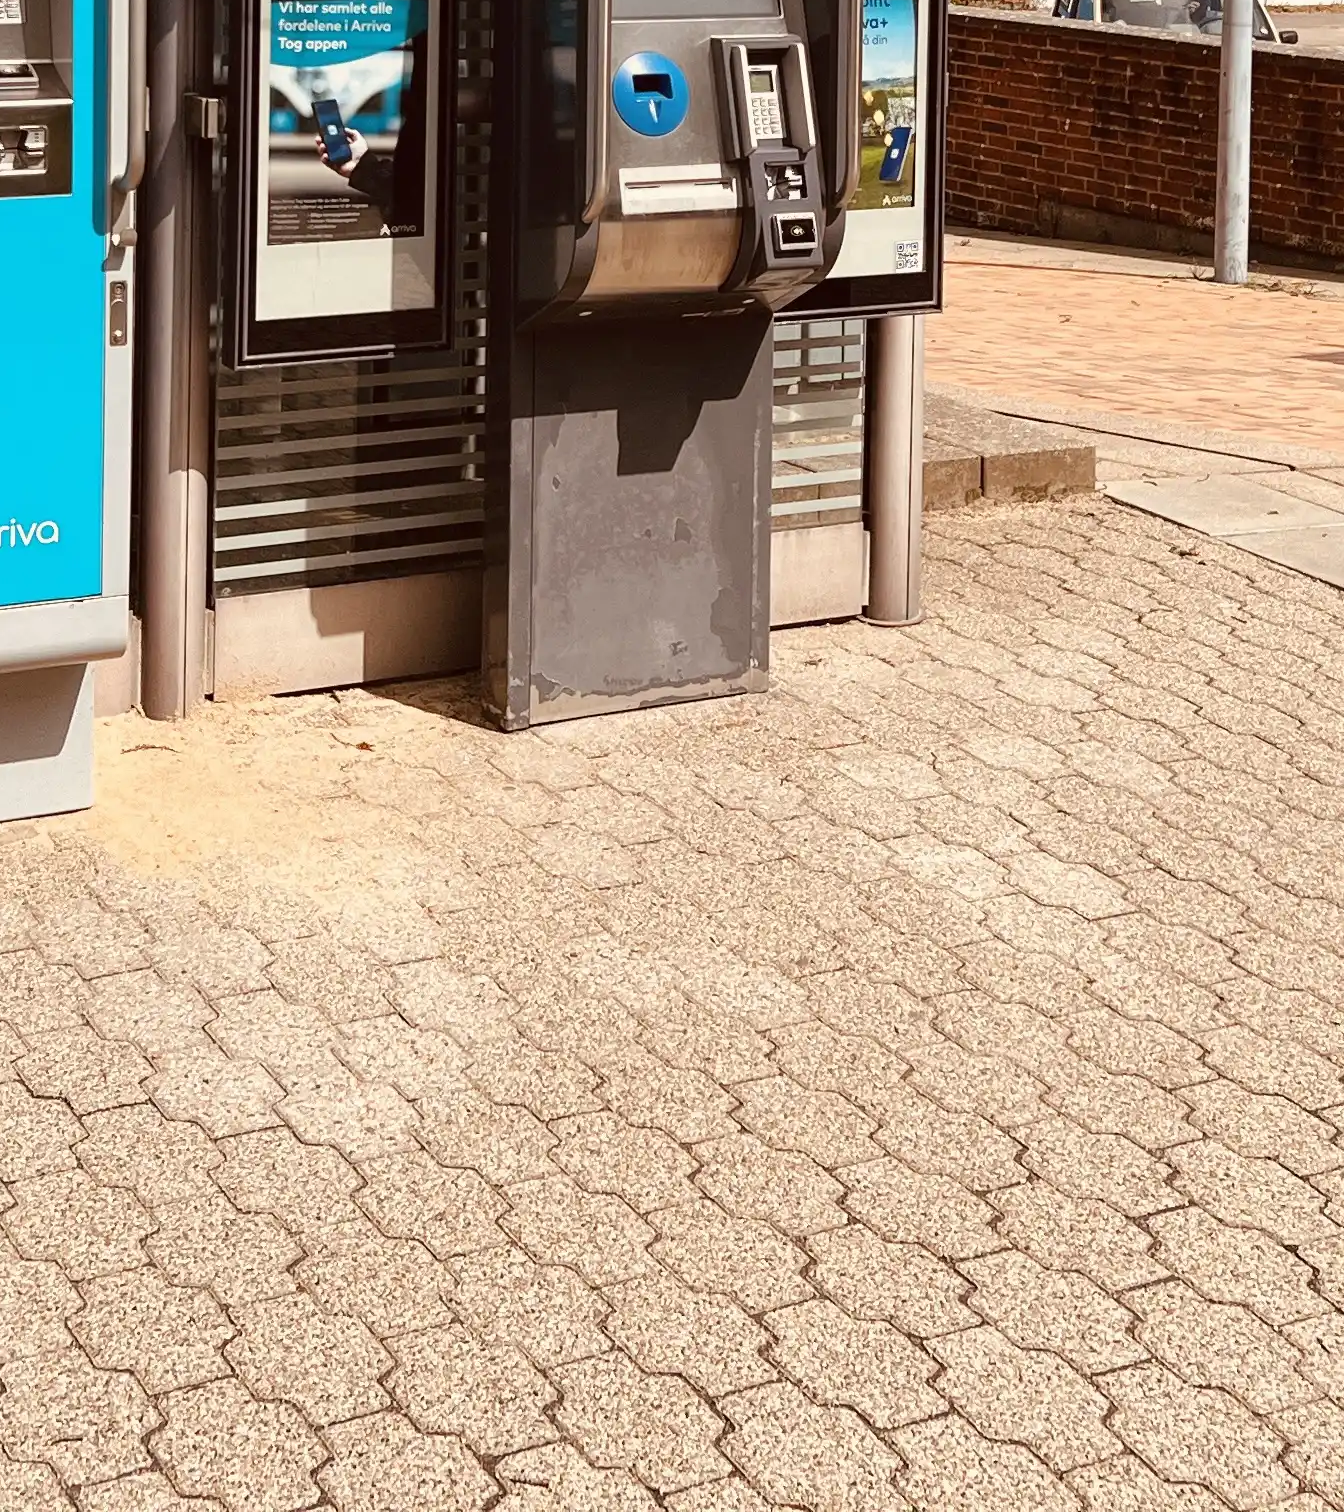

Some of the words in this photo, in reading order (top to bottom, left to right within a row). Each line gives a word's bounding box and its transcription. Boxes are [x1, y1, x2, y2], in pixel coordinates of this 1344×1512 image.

[279, 2, 293, 13] Vi
[296, 2, 318, 13] har
[322, 2, 366, 13] samlet
[370, 2, 392, 14] alle
[279, 19, 341, 31] fordelene
[352, 20, 390, 31] Arriva
[278, 37, 302, 52] Tog
[306, 41, 346, 52] appen
[872, 34, 889, 46] din
[391, 224, 417, 233] arriva
